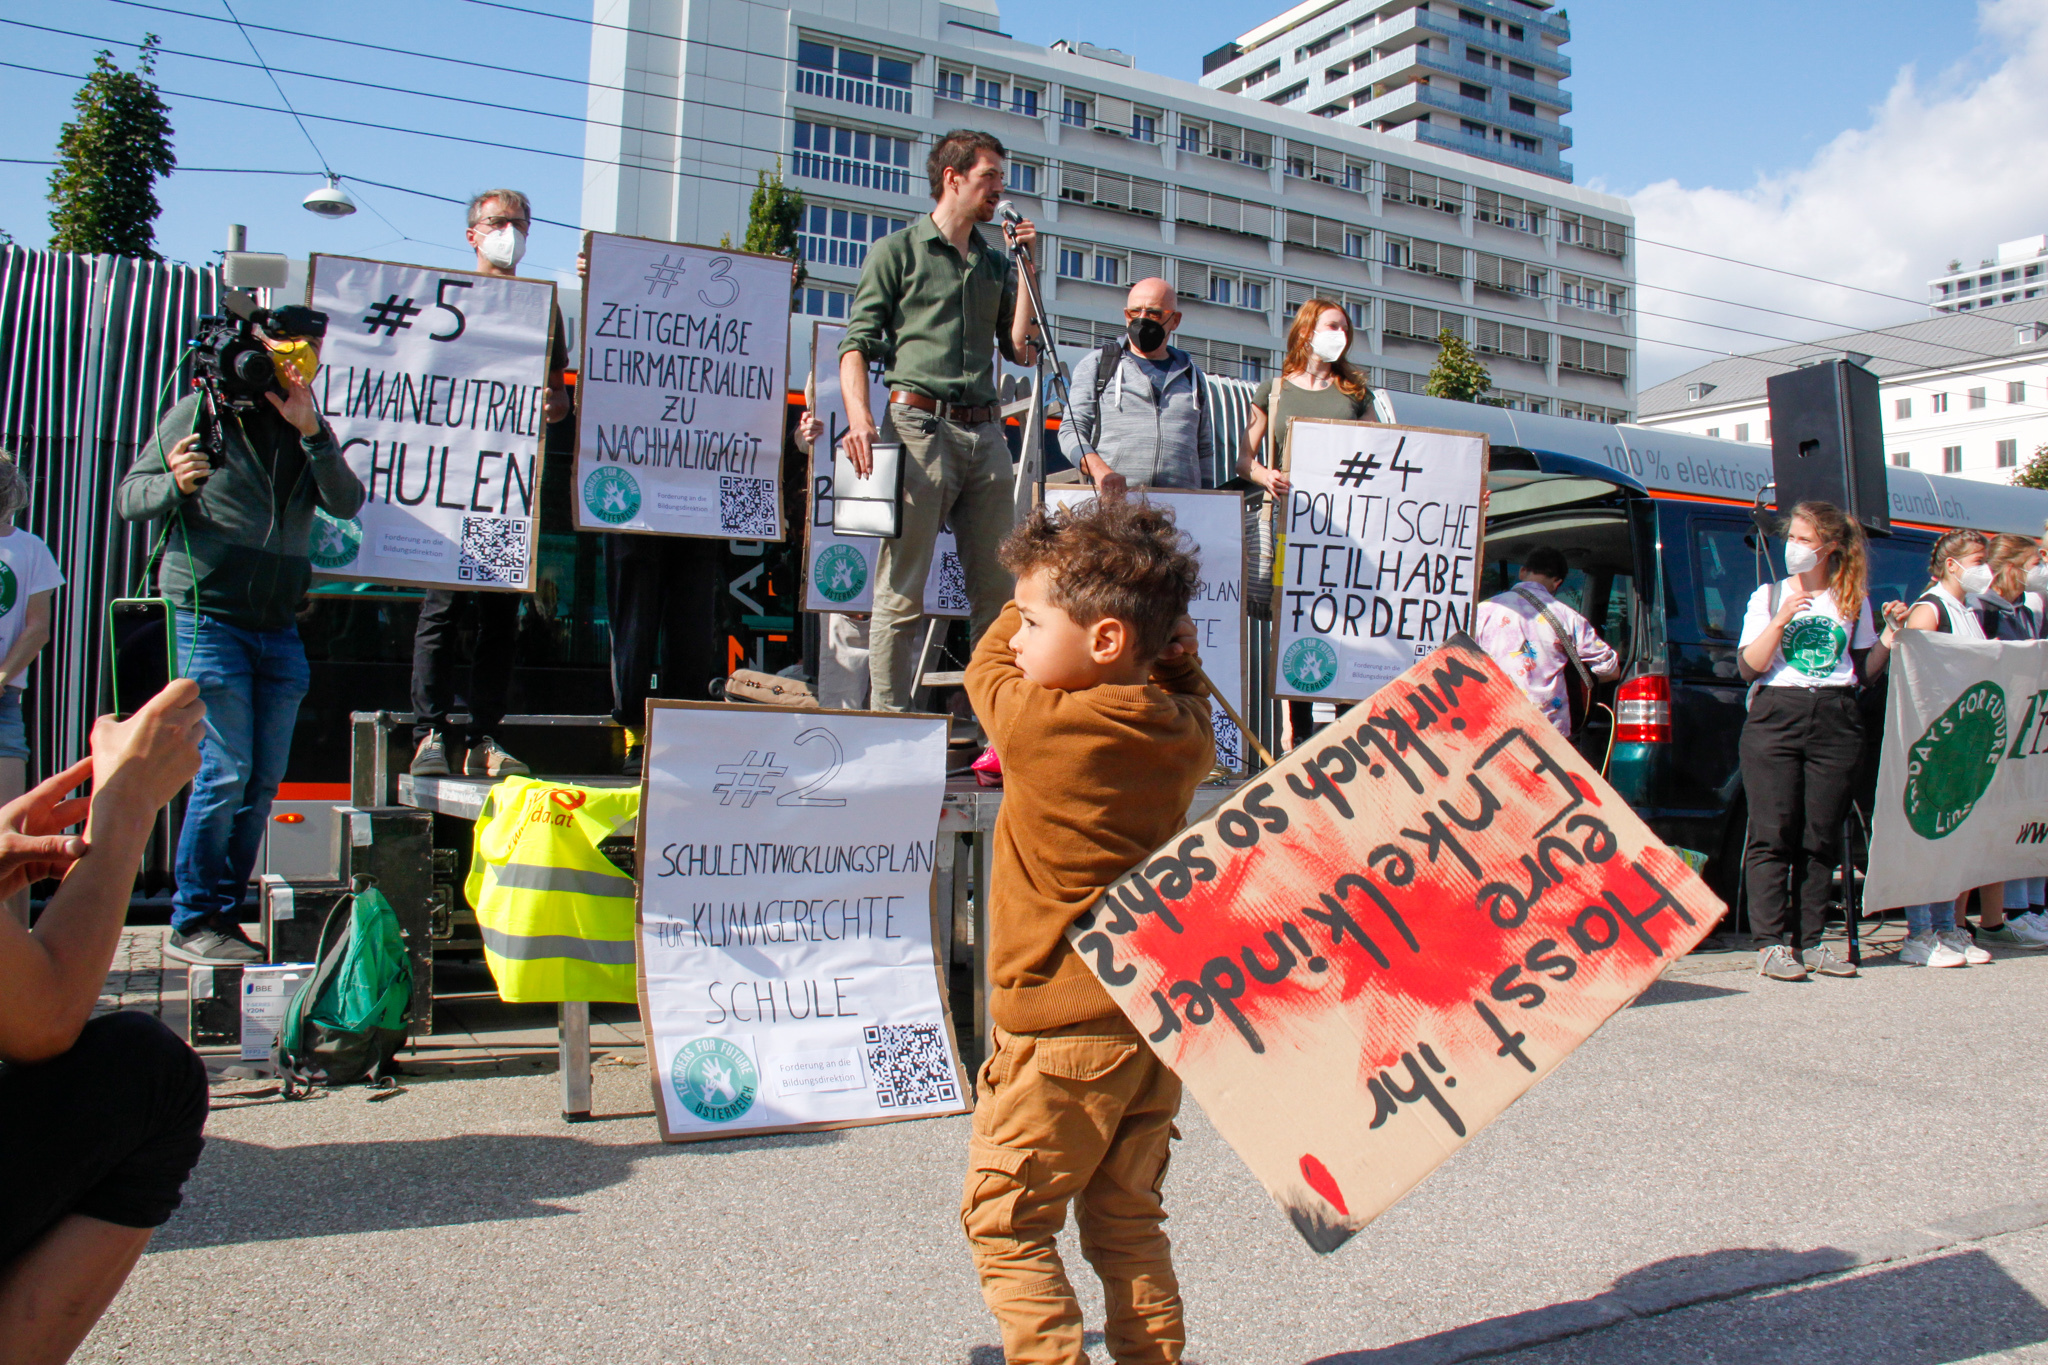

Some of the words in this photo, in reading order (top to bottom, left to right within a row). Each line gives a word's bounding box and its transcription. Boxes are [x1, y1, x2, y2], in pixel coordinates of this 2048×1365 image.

[643, 253, 740, 308] #3
[362, 278, 474, 342] #5
[589, 346, 773, 400] LEHRMATERIALIEN
[660, 395, 696, 424] ZU
[584, 471, 602, 505] TEACHERS
[603, 467, 618, 476] FOR
[619, 470, 639, 496] FUTURE
[1333, 435, 1423, 493] #4
[1602, 445, 1643, 476] 100
[1888, 491, 1970, 520] eundlich.
[596, 502, 640, 524] ÖSTERREICH
[657, 492, 689, 502] Forderung
[698, 494, 707, 502] die
[657, 502, 708, 513] Bildungsdirektion
[1291, 490, 1477, 550] POLITISCHE
[383, 544, 444, 558] Bildungsdirektion
[384, 532, 421, 545] Forderung
[421, 537, 431, 545] an
[432, 537, 444, 546] die
[815, 550, 833, 584] TEACHERS
[834, 545, 847, 555] FOR
[848, 548, 866, 572] FUTURE
[824, 579, 865, 601] ÖSTERREICH
[1288, 543, 1473, 596] TEILHABE
[1286, 587, 1471, 642] FÖRDERN
[1782, 617, 1813, 649] FRIDAYS
[1815, 617, 1838, 631] FOR
[1284, 642, 1301, 675] TEACHERS
[1303, 638, 1317, 647] FOR
[1318, 641, 1336, 665] FUTURE
[1291, 671, 1334, 692] ÖSTERREICH
[1353, 661, 1383, 672] Forderung
[1287, 655, 1488, 820] wirklich
[1958, 688, 1987, 720] FOR
[1986, 693, 2007, 765] FUTURE
[712, 726, 847, 808] #2
[1217, 782, 1290, 848] so
[657, 840, 935, 877] SCHULENTWICKLUNGSPLAN
[1475, 812, 1619, 930] eure
[1073, 834, 1217, 987] sehr?
[1148, 727, 1583, 1055] Enkelkinder
[656, 914, 685, 948] FÜR
[693, 895, 905, 948] KLIMAGERECHTE
[1475, 861, 1698, 1074] Hasst
[706, 977, 859, 1023] SCHULE
[673, 1047, 695, 1098] TEACHERS
[695, 1039, 716, 1053] FOR
[720, 1042, 754, 1075] FUTURE
[779, 1060, 824, 1073] Forderung
[825, 1060, 836, 1068] an
[838, 1057, 851, 1067] die
[782, 1073, 856, 1088] Bildungsdirektion
[1368, 1041, 1467, 1138] ihr
[694, 1085, 755, 1120] ÖSTERREICH
